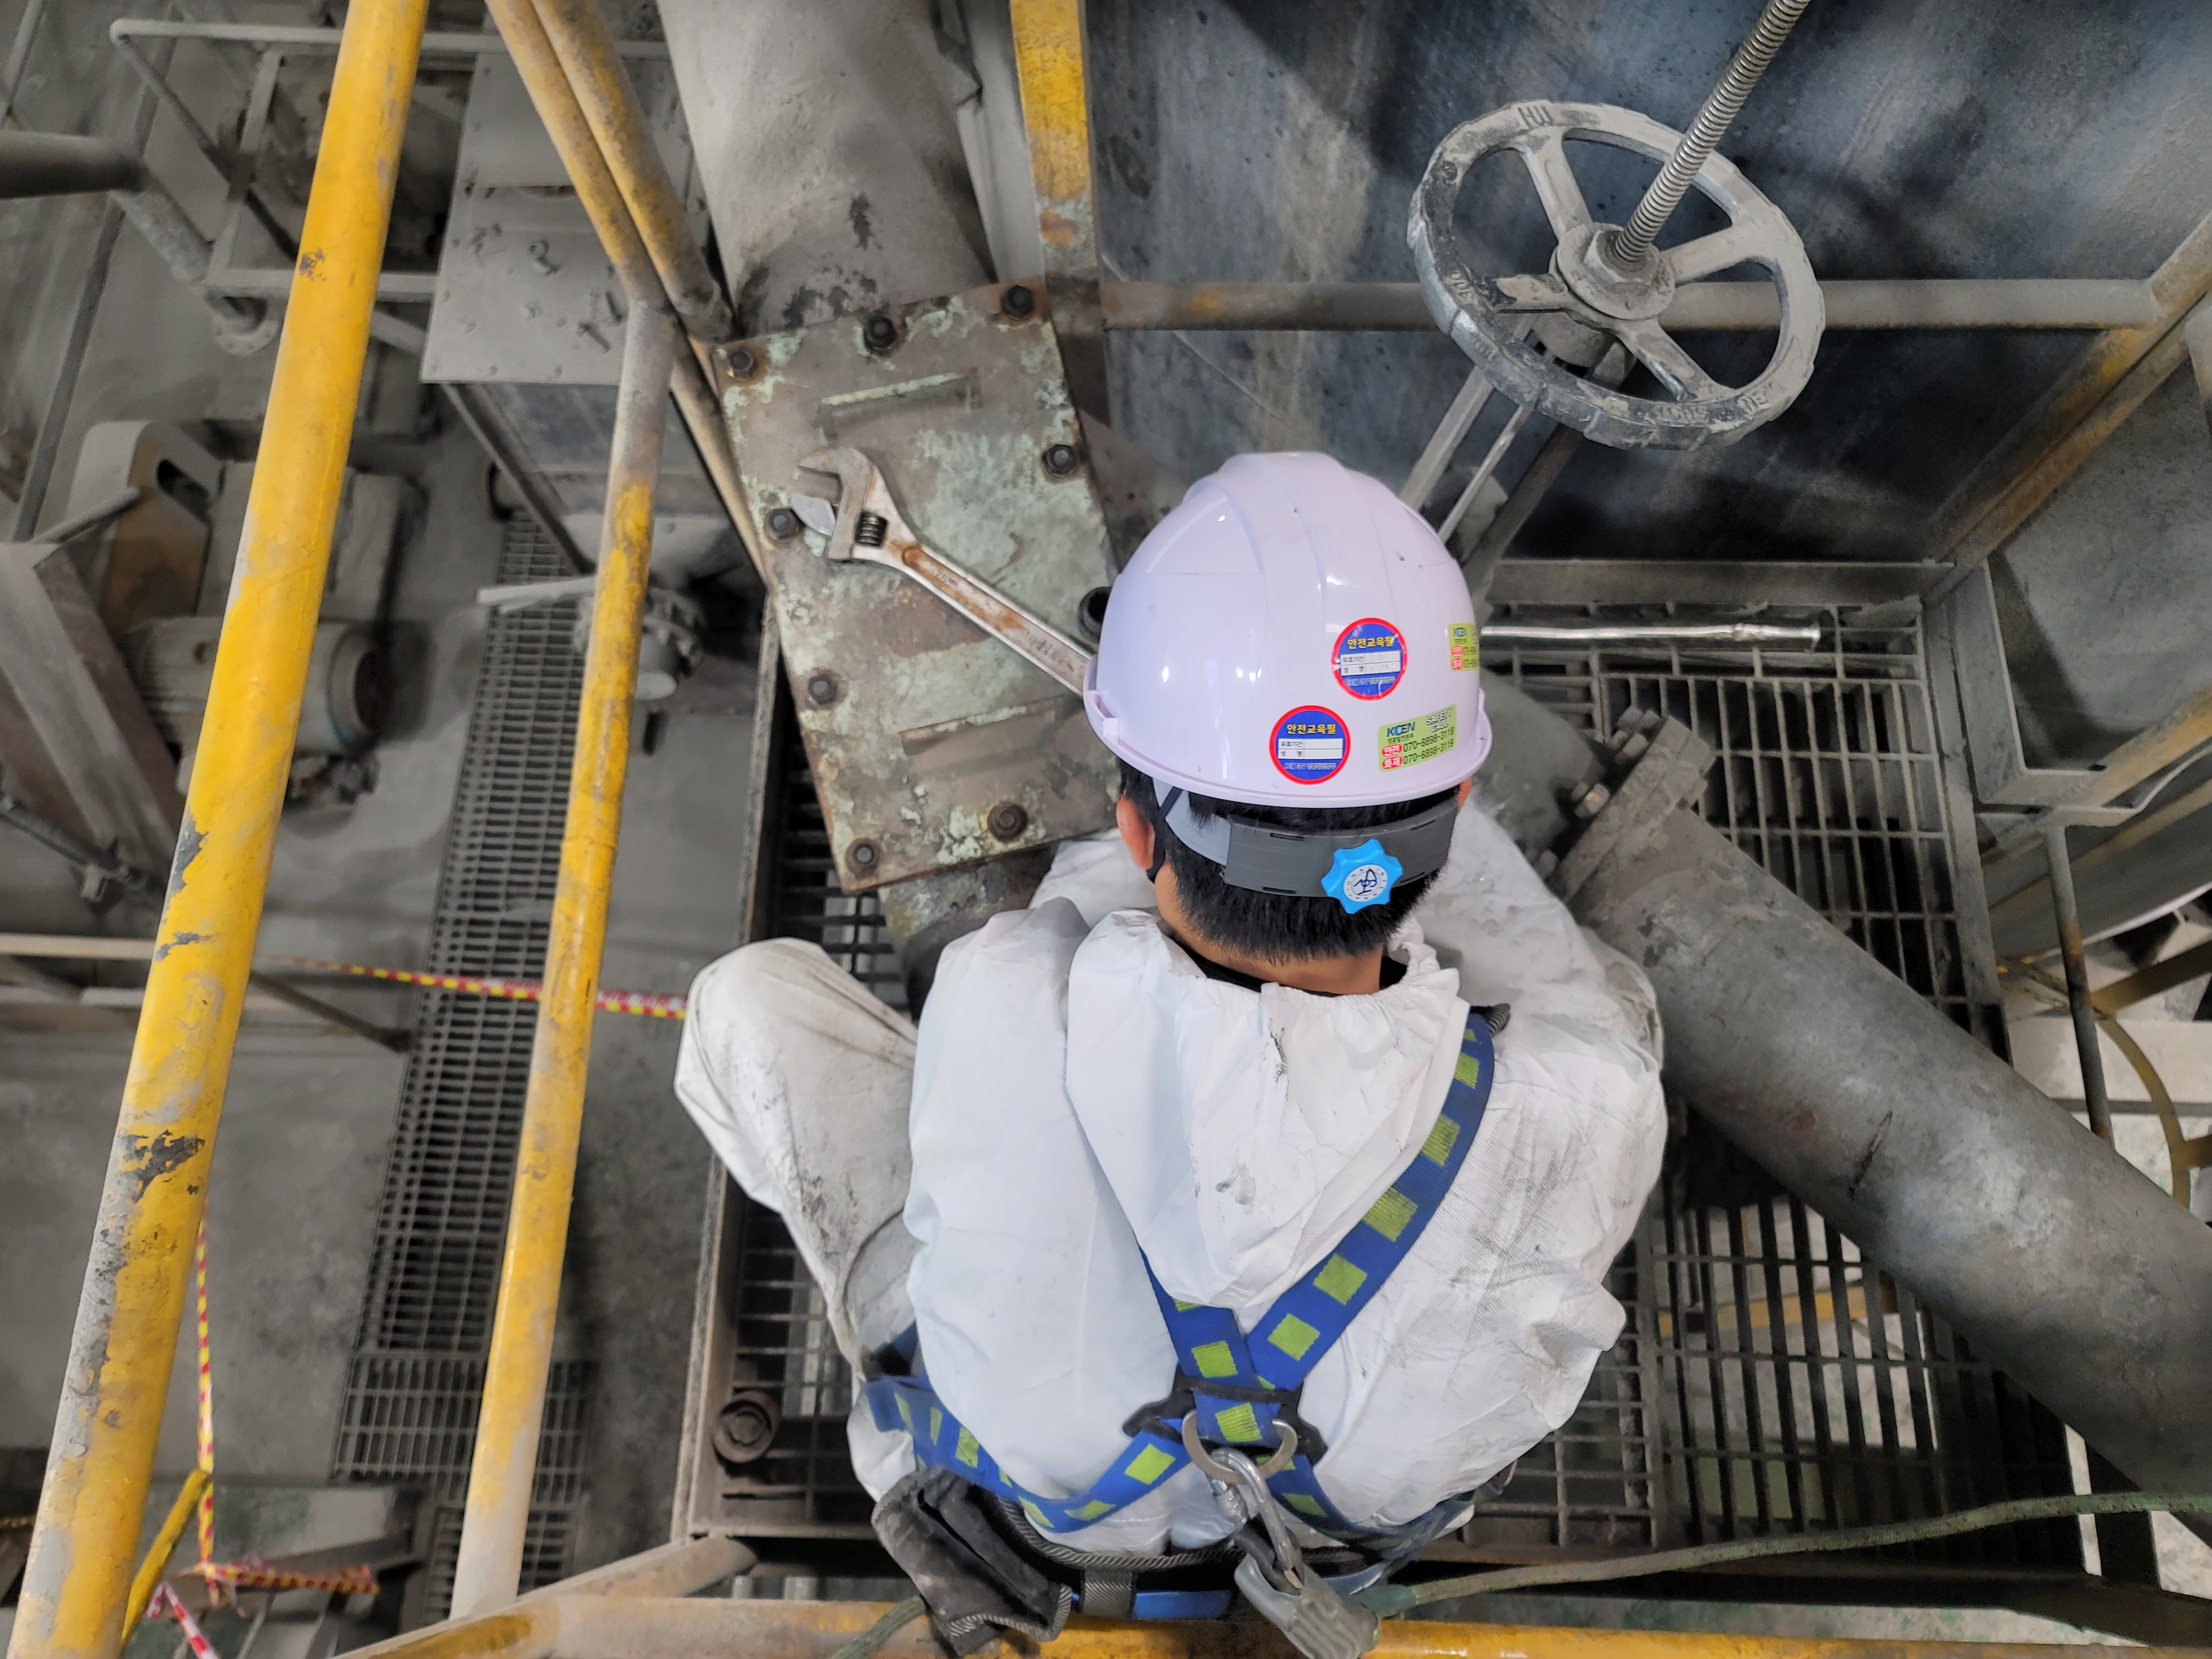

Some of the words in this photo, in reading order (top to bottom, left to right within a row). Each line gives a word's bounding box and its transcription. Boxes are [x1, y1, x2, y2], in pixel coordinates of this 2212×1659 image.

[1347, 635, 1395, 650] 안전교육필
[1426, 707, 1453, 726] SAFETY
[1286, 723, 1337, 735] 안전교육필
[1431, 719, 1449, 733] CALL
[1384, 744, 1400, 757] 안전
[1384, 757, 1401, 769] 화재
